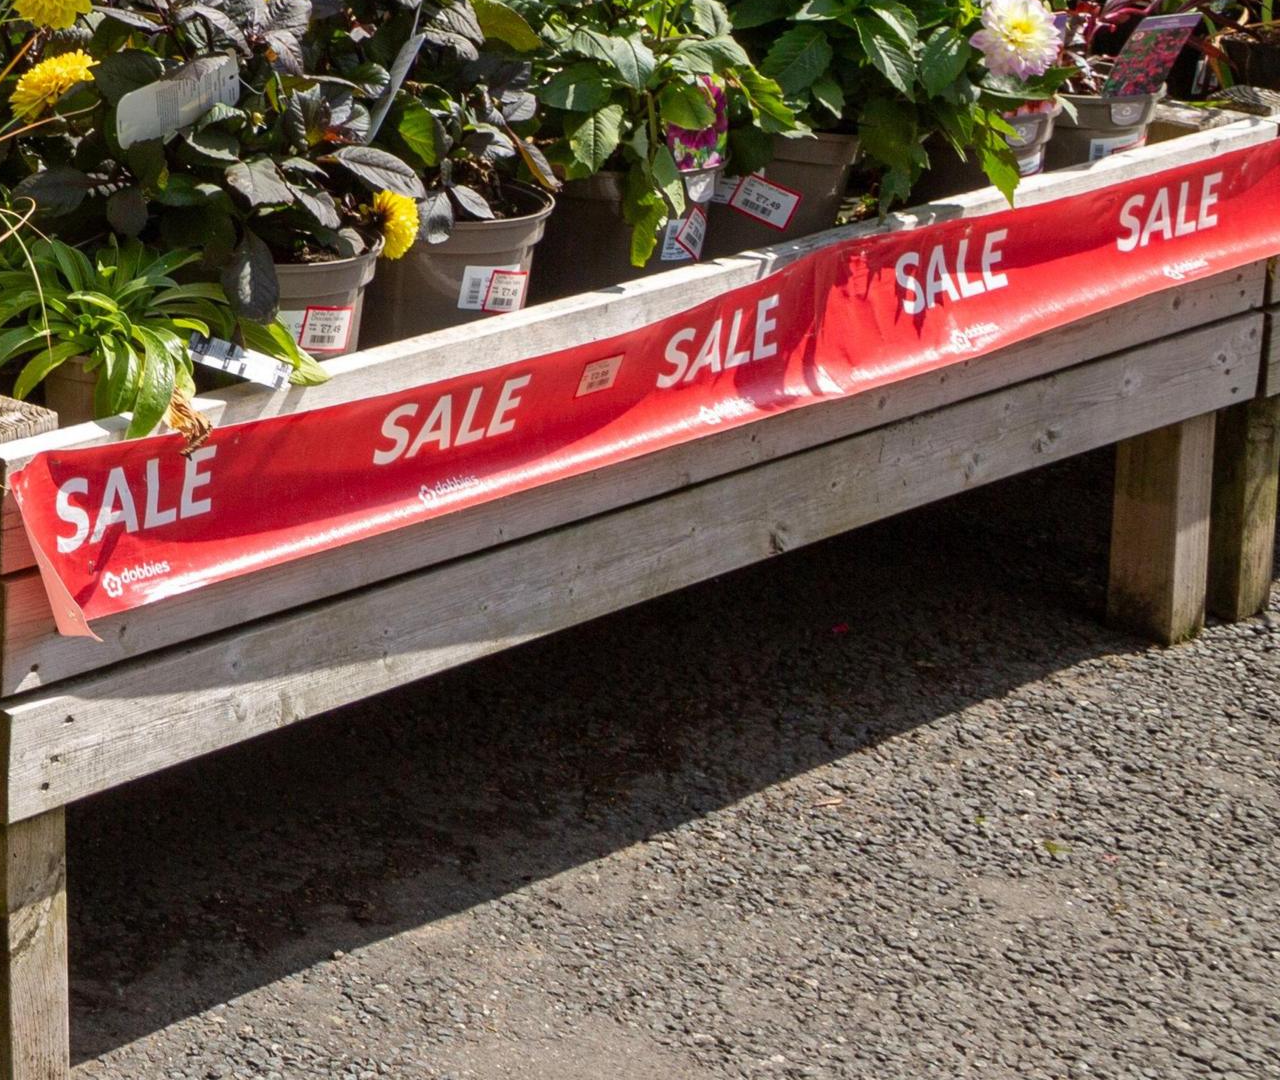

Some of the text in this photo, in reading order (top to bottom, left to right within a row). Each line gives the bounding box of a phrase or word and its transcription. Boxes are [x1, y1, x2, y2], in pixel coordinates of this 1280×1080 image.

[1116, 171, 1224, 253] SALE
[896, 229, 1008, 315] SALE
[656, 294, 780, 389] SALE
[372, 374, 532, 466] SALE
[56, 445, 213, 554] SALE
[435, 474, 481, 496] dobbies
[120, 560, 171, 583] dobbies
